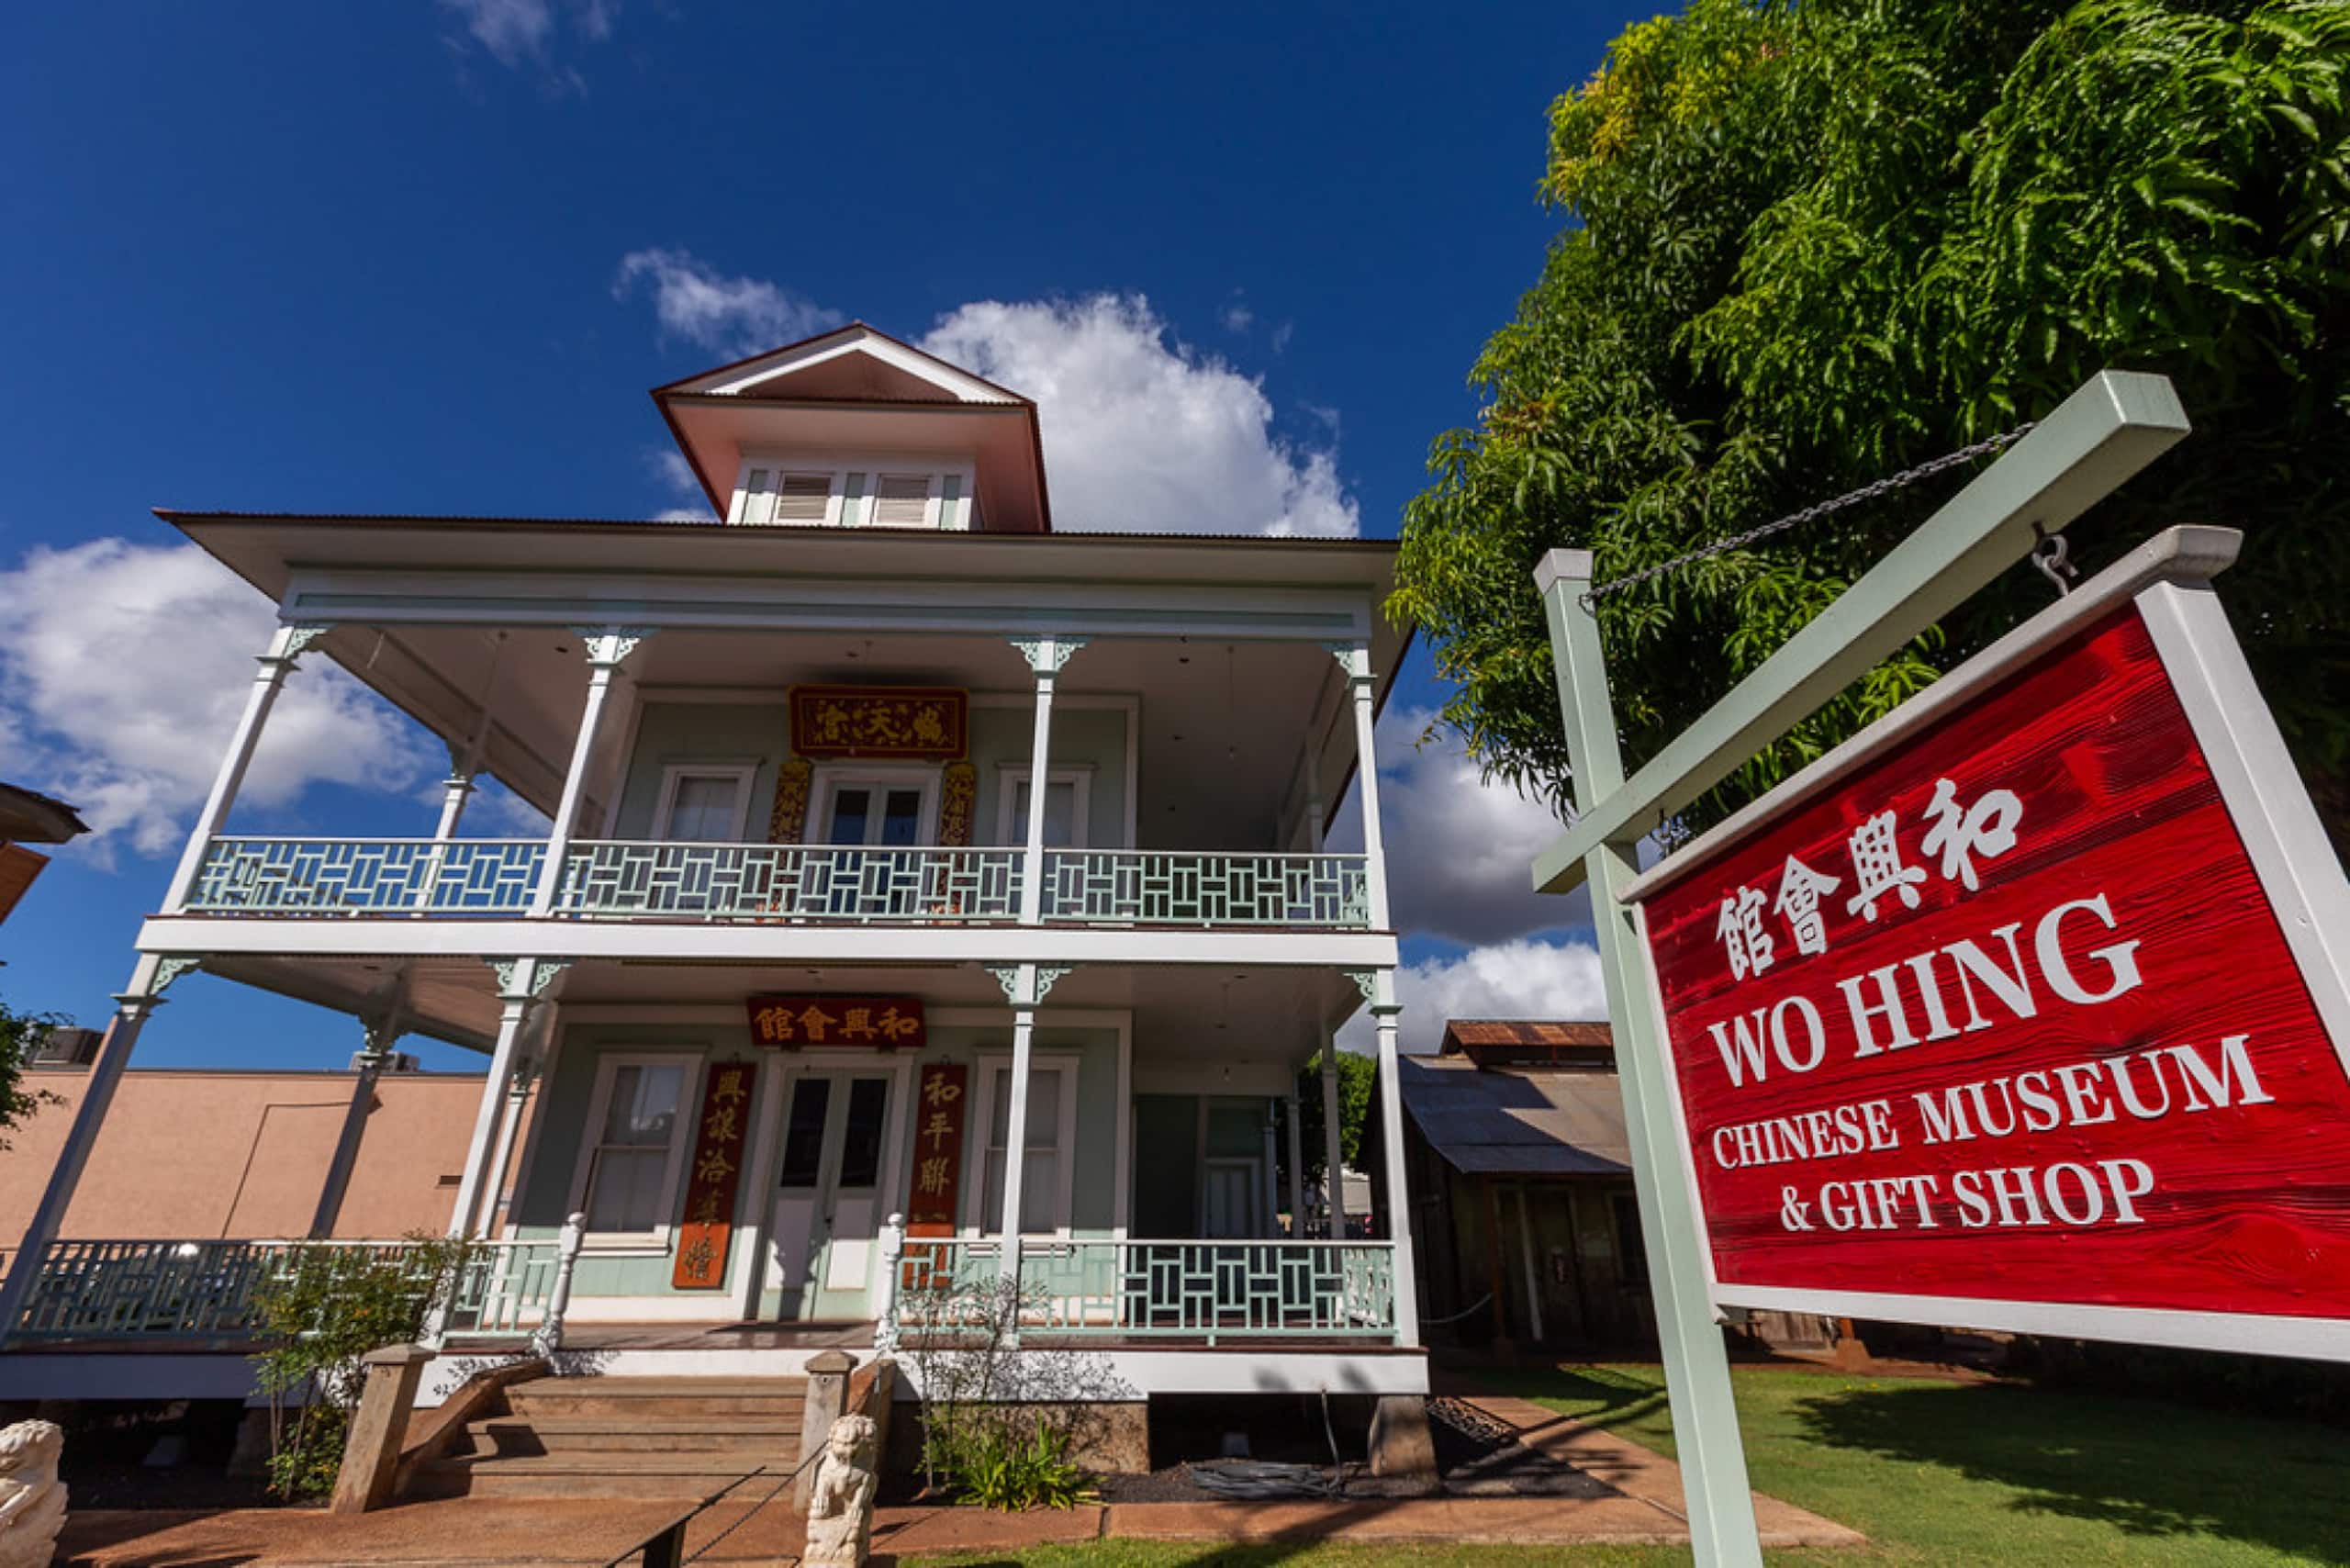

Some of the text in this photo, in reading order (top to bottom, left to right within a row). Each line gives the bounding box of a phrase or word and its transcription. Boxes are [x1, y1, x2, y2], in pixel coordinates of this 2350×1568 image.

[1707, 892, 2143, 1087] WO HING
[1713, 1033, 2275, 1170] CHINESE MUSEUM
[1781, 1158, 2154, 1231] & GIFT SHOP
